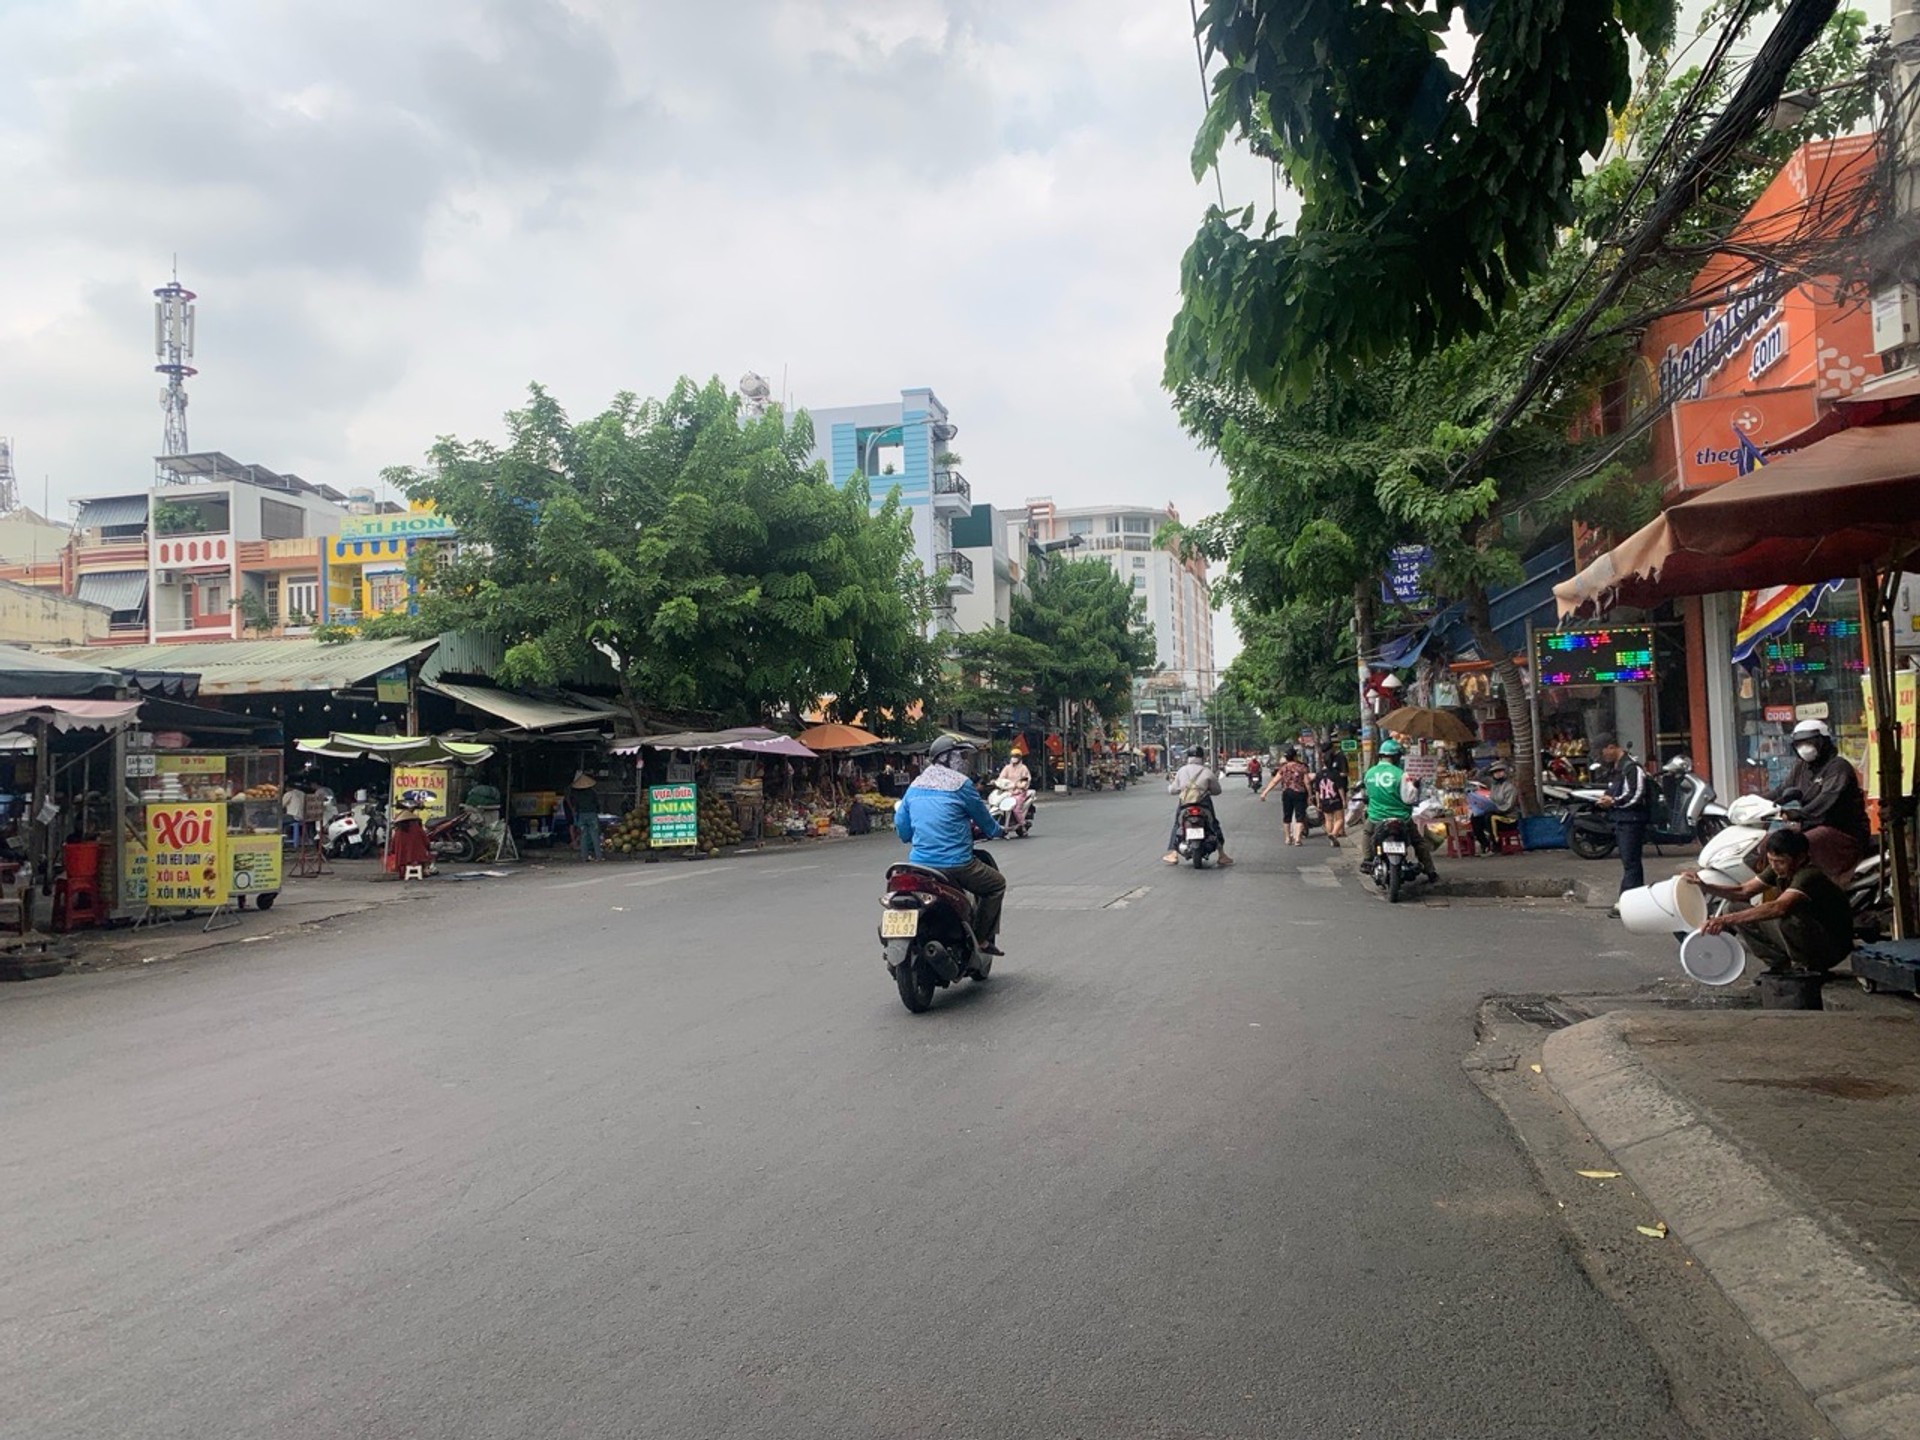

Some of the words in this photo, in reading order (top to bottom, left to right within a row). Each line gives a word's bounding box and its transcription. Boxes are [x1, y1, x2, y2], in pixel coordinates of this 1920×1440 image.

[152, 809, 213, 849] Xôi
[156, 869, 173, 882] XÔI
[156, 885, 173, 899] XÔI
